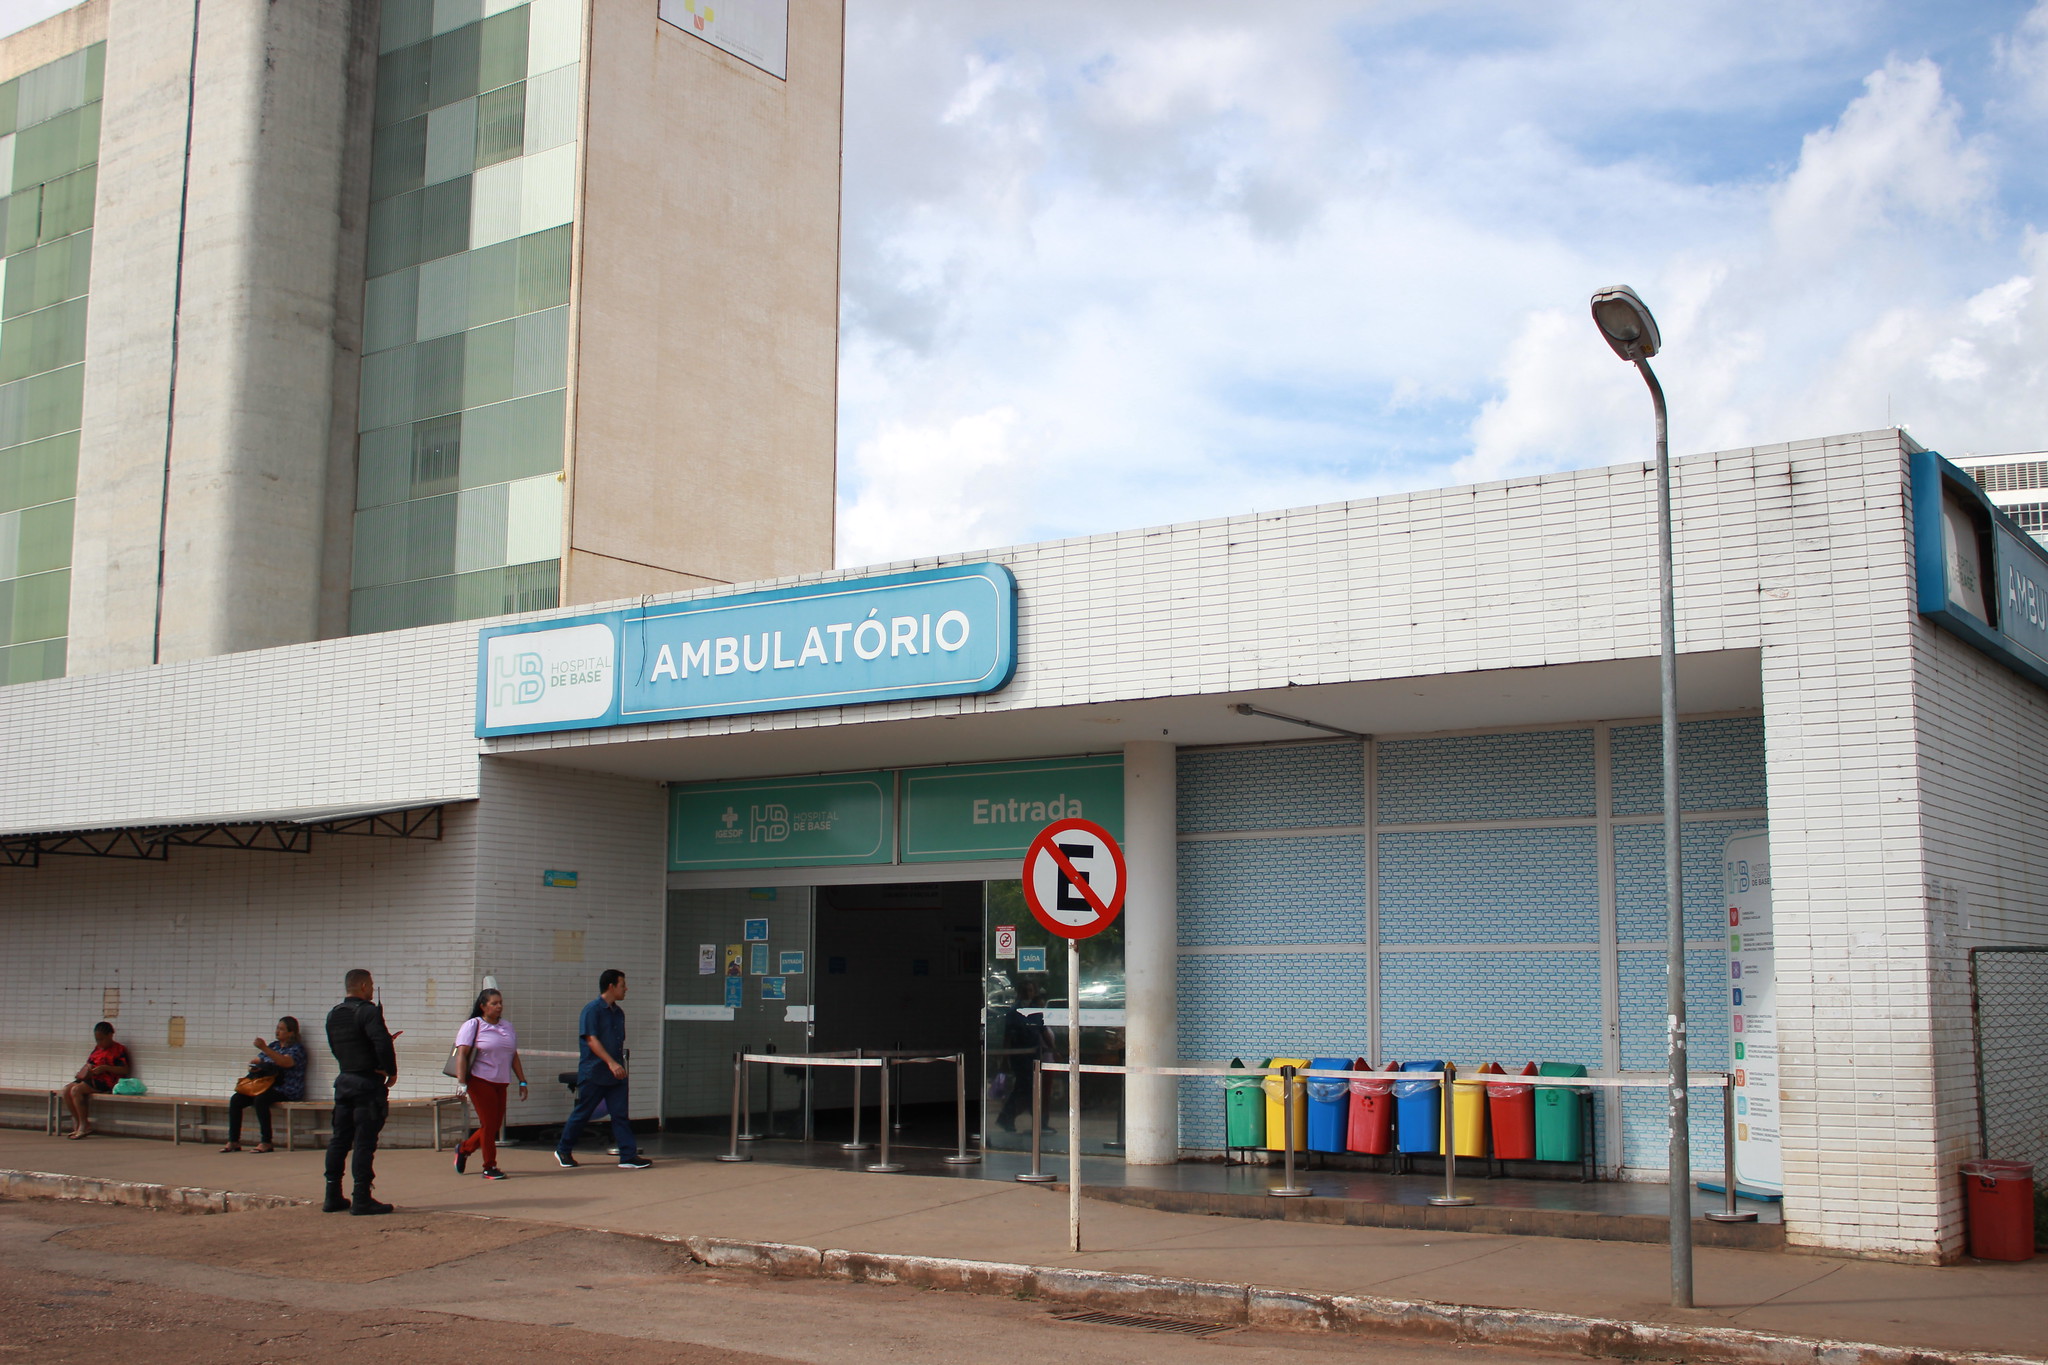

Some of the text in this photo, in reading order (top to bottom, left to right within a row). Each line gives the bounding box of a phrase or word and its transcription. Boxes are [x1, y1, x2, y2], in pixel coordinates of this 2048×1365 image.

[651, 608, 970, 682] AMBULATÓRIO
[551, 656, 612, 674] HOSPITAL
[551, 670, 602, 687] DE BASE
[973, 793, 1083, 825] Entrada
[793, 811, 839, 822] HOSPITAL
[793, 821, 831, 832] DE BASE
[715, 829, 743, 839] IGESDF
[1057, 843, 1094, 912] E
[1751, 877, 1770, 887] DE BASE
[1023, 953, 1041, 962] SAÍDA
